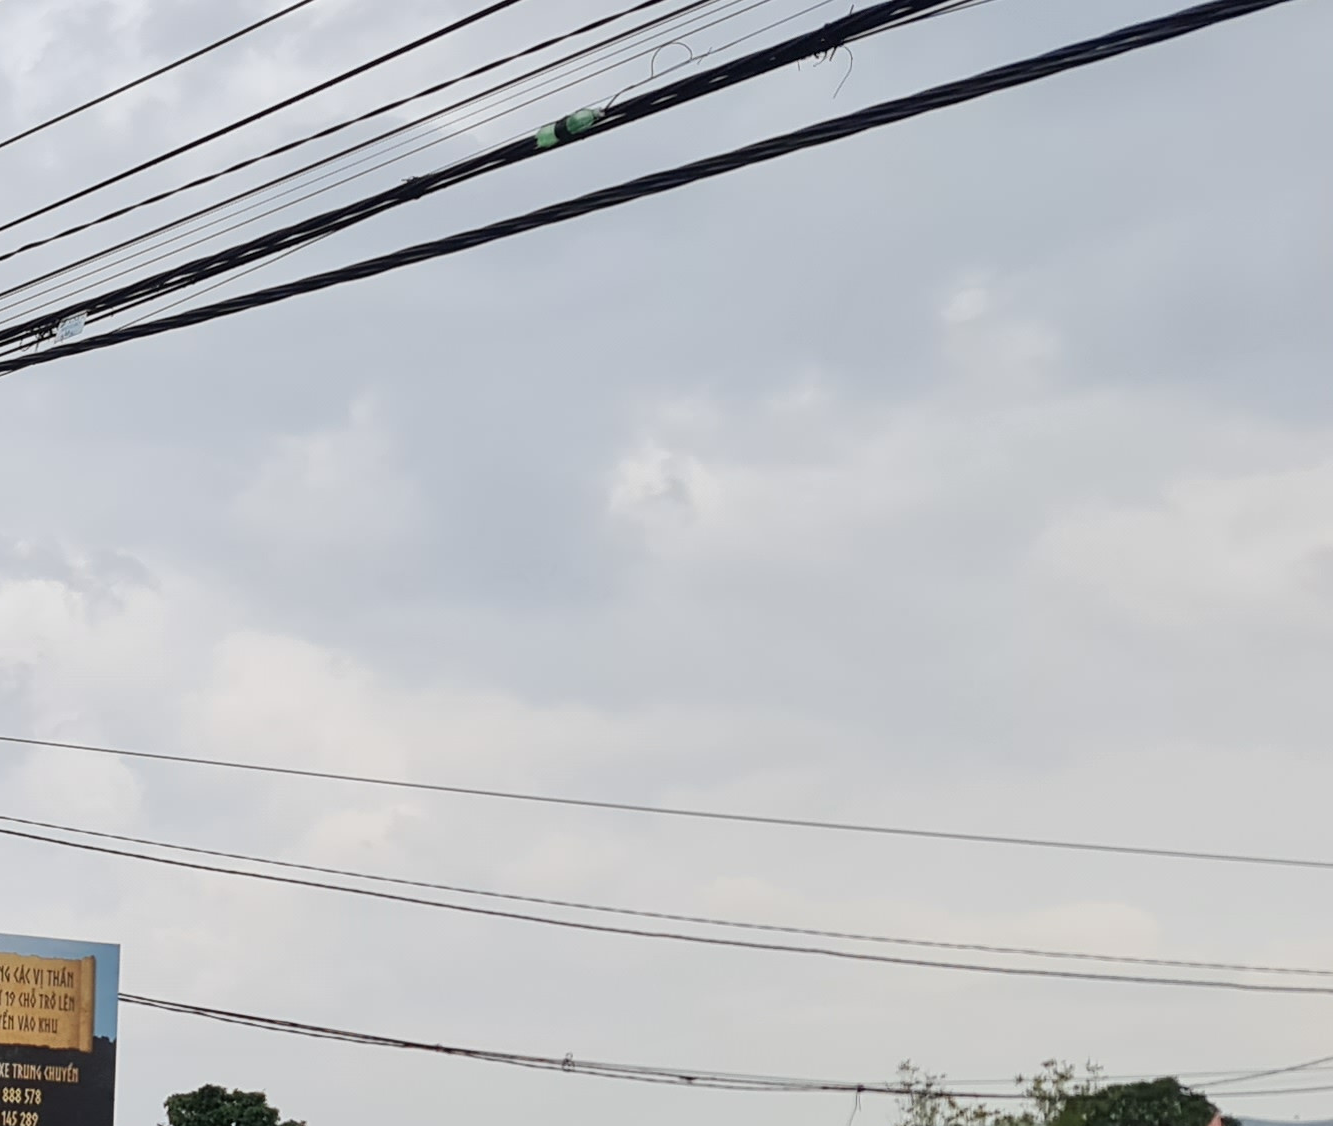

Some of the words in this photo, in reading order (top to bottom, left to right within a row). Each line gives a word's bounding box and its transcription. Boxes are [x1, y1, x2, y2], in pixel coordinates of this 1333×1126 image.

[13, 963, 31, 985] CÁC
[33, 968, 44, 989] VỊ
[5, 991, 16, 1007] 19
[58, 992, 75, 1012] LÊN
[17, 1013, 36, 1032] VÀO
[38, 1017, 58, 1034] KHU
[12, 1062, 42, 1081] TRUNG
[2, 1086, 22, 1104] 888
[24, 1088, 42, 1105] 578
[1, 1110, 18, 1126] 145
